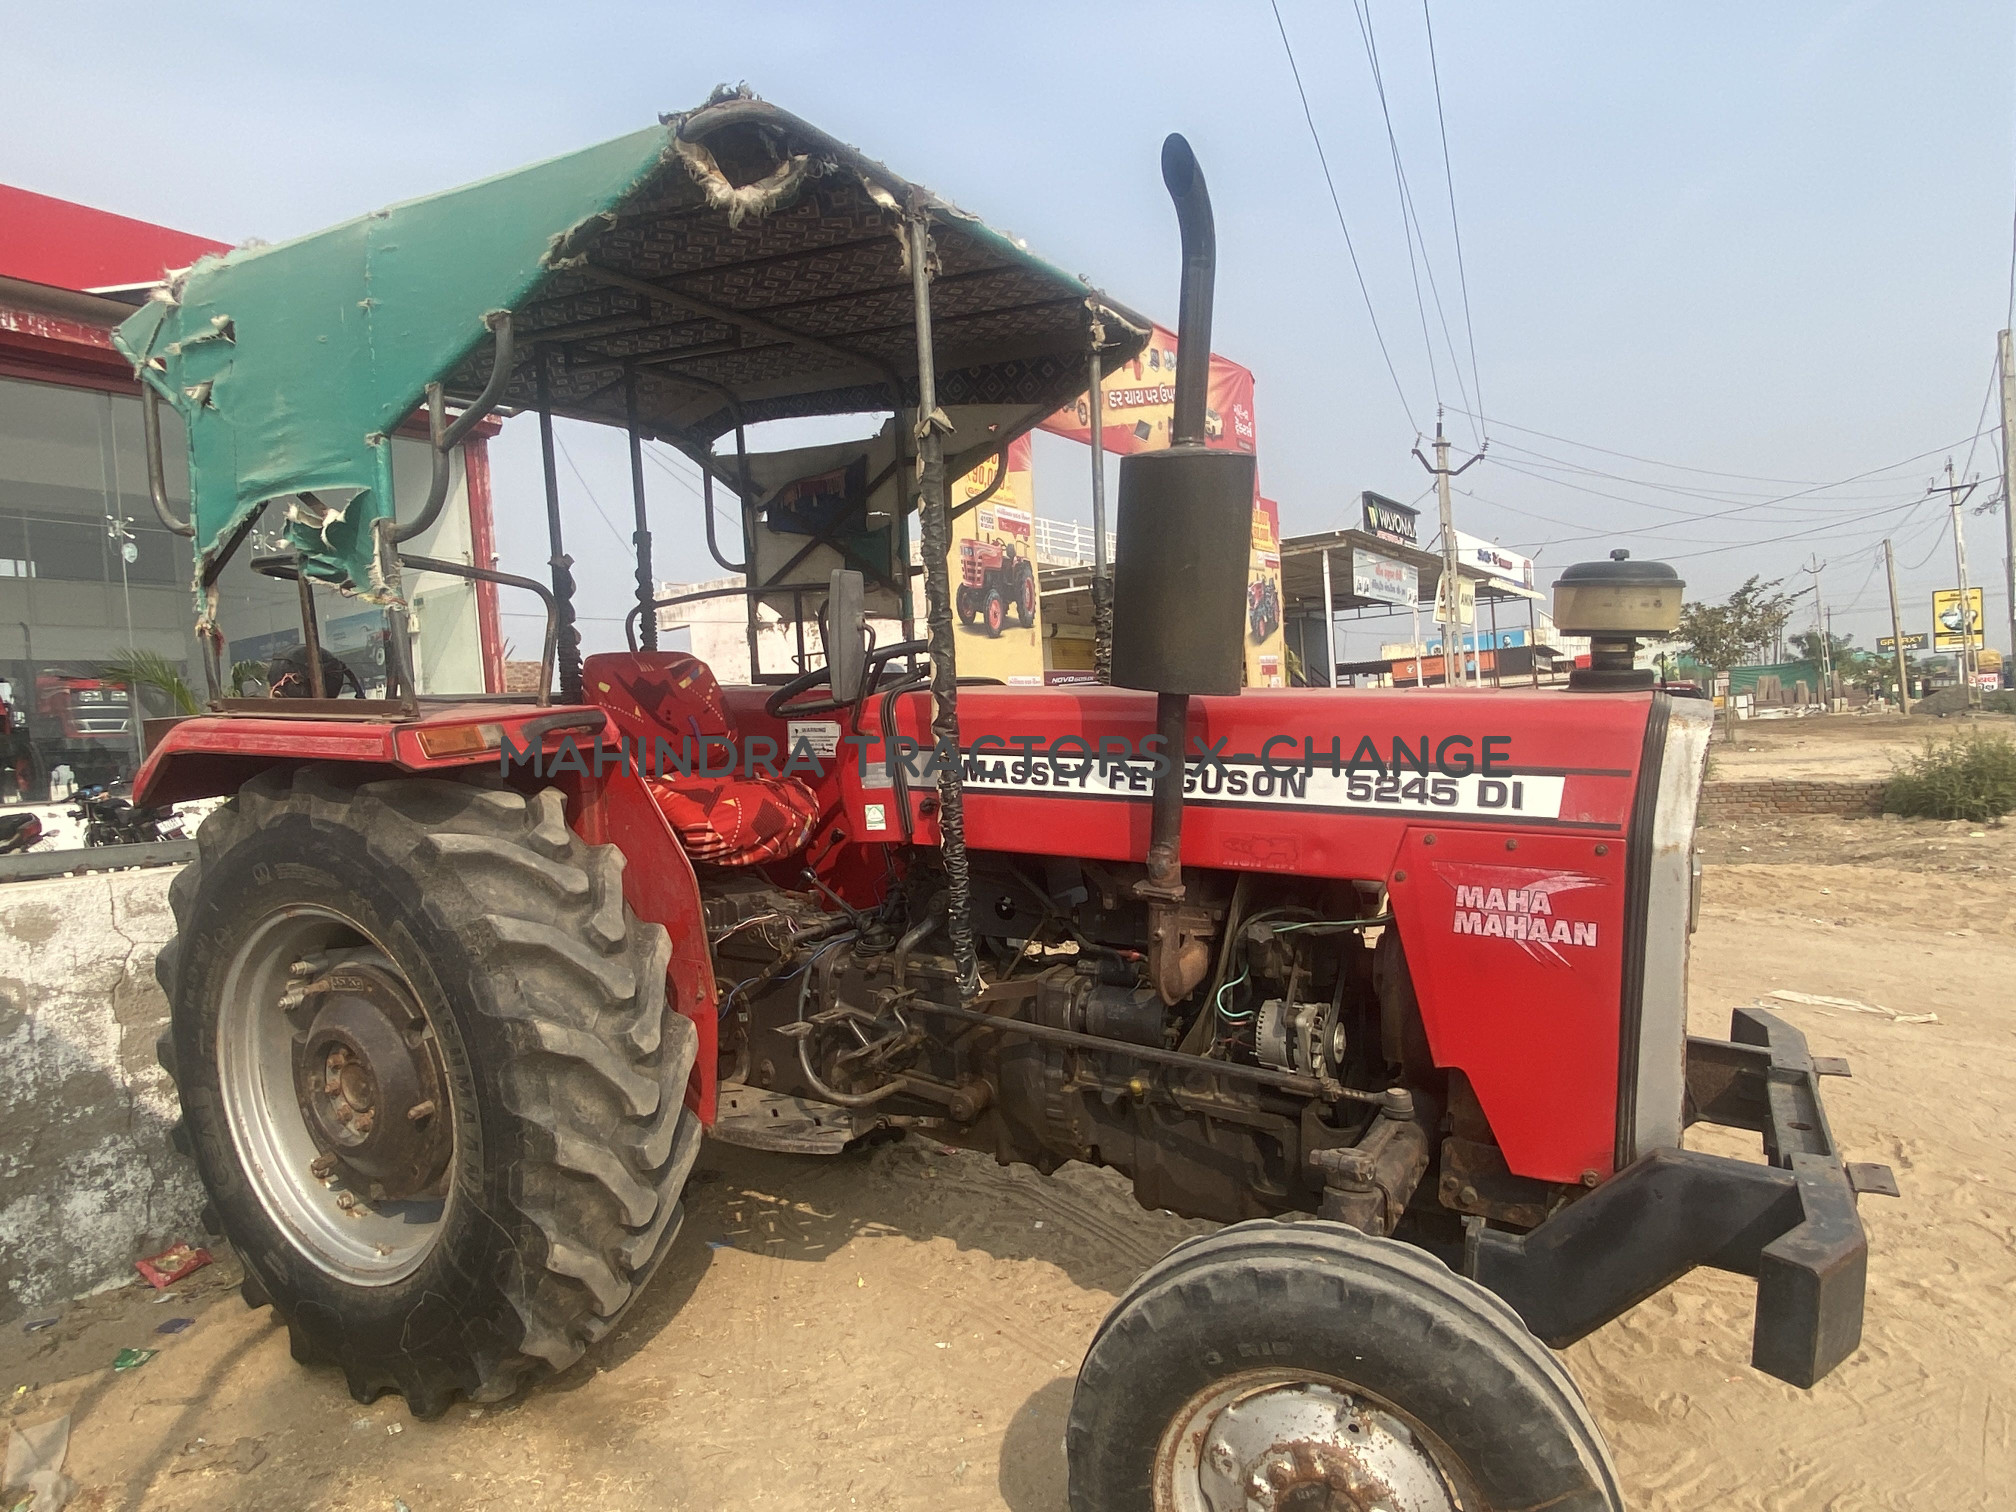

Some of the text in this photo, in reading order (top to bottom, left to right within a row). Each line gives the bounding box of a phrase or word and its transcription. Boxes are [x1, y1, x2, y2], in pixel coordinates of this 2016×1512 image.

[1109, 390, 1123, 408] હર
[1145, 388, 1159, 404] પર
[1159, 383, 1176, 403] ઉપ
[1879, 635, 1923, 646] GAAXY
[1051, 676, 1075, 684] NOVO
[962, 759, 1523, 811] MASSEY FEGUSON 5245 DI
[1455, 884, 1553, 916] MAHA
[1452, 909, 1599, 948] MAHAAN
